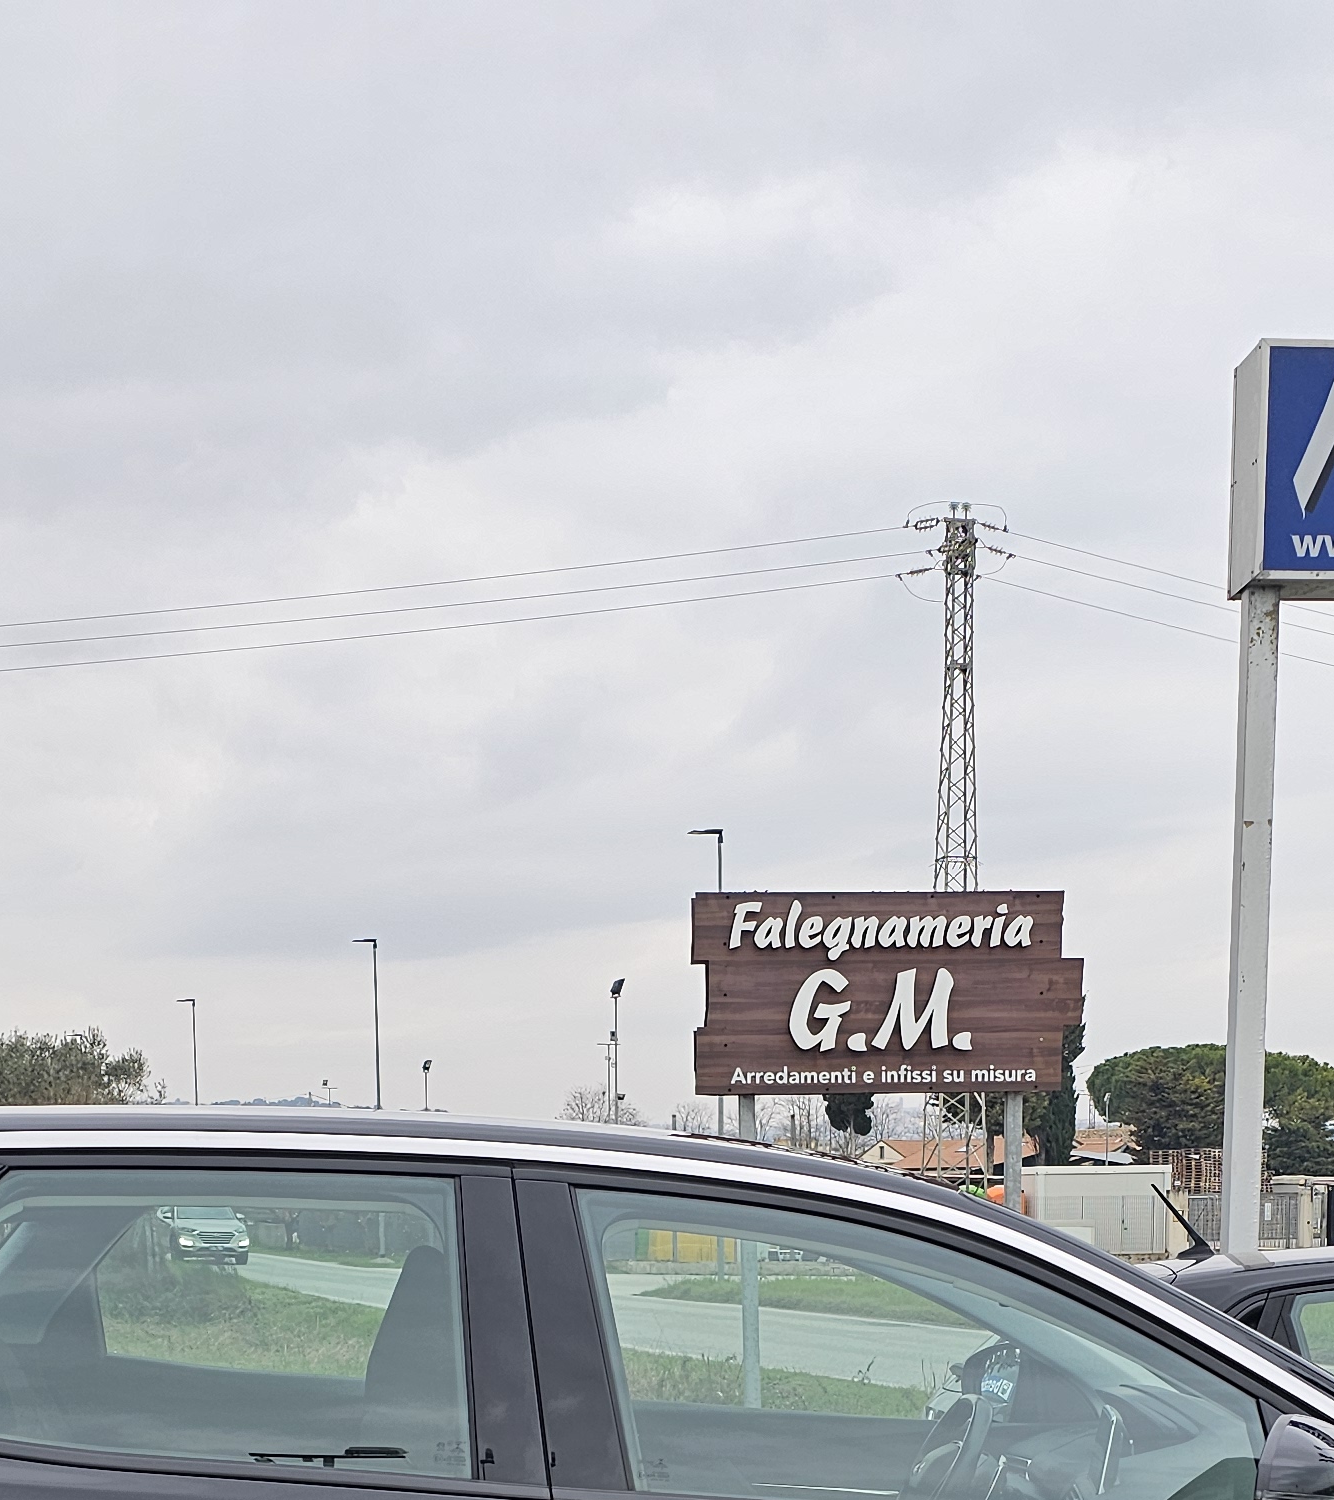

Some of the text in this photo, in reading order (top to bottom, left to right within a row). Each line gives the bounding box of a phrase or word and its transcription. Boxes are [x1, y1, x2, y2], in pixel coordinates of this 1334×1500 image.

[729, 900, 1034, 961] Falegnameria
[788, 967, 973, 1052] G.M.
[731, 1065, 1036, 1085] Arredamenti e infissi su misura
